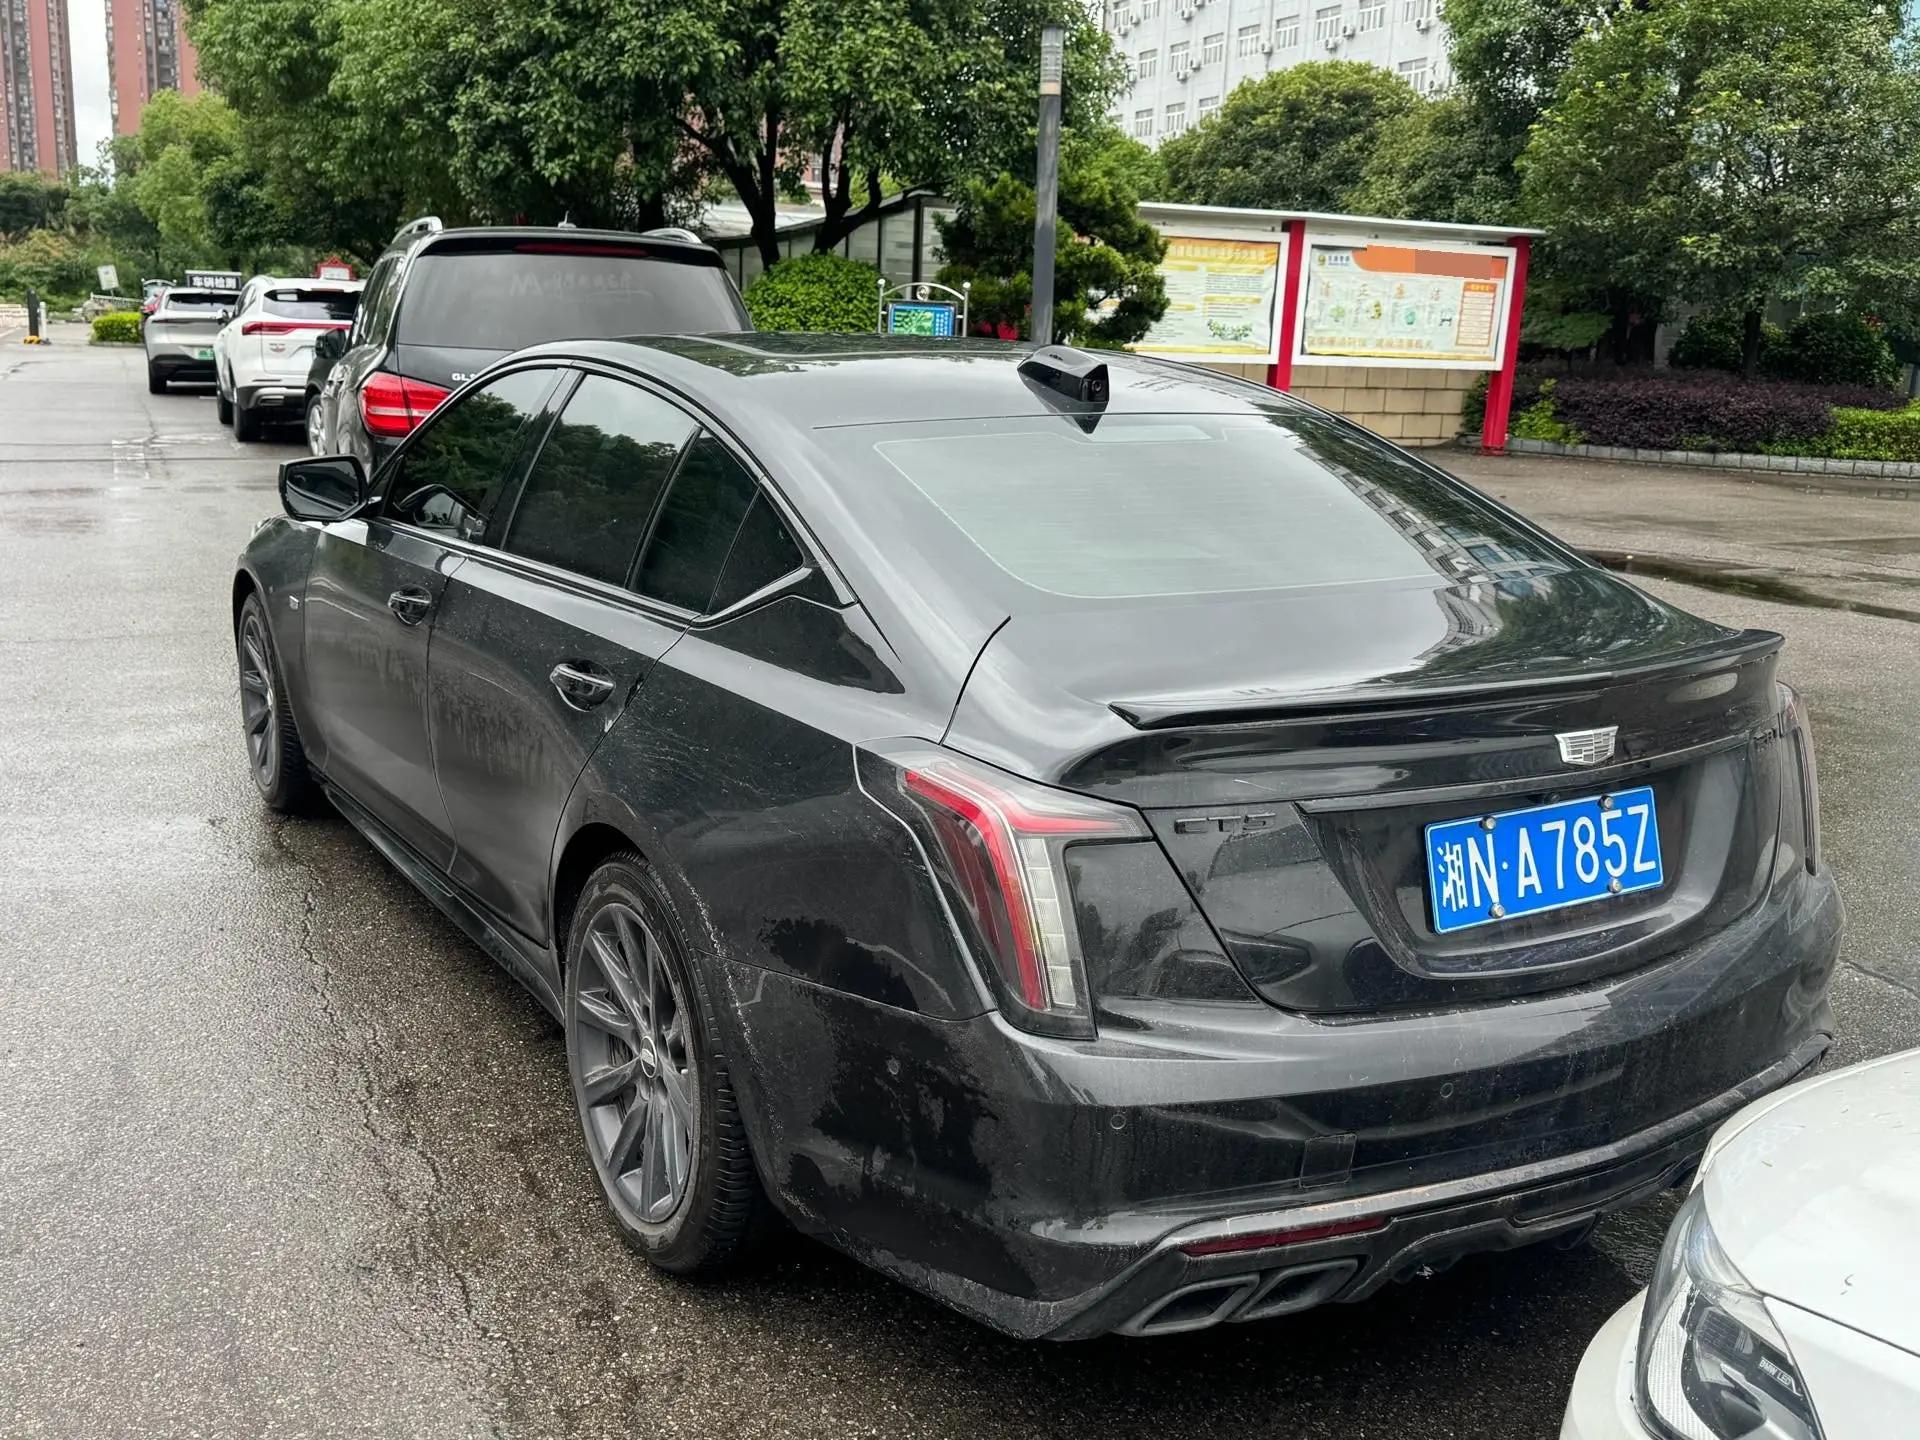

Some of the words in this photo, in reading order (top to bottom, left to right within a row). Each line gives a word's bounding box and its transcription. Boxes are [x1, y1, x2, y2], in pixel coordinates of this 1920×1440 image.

[1174, 812, 1276, 834] CT5
[1759, 1359, 1778, 1376] BMW
[1776, 1371, 1792, 1386] LED
